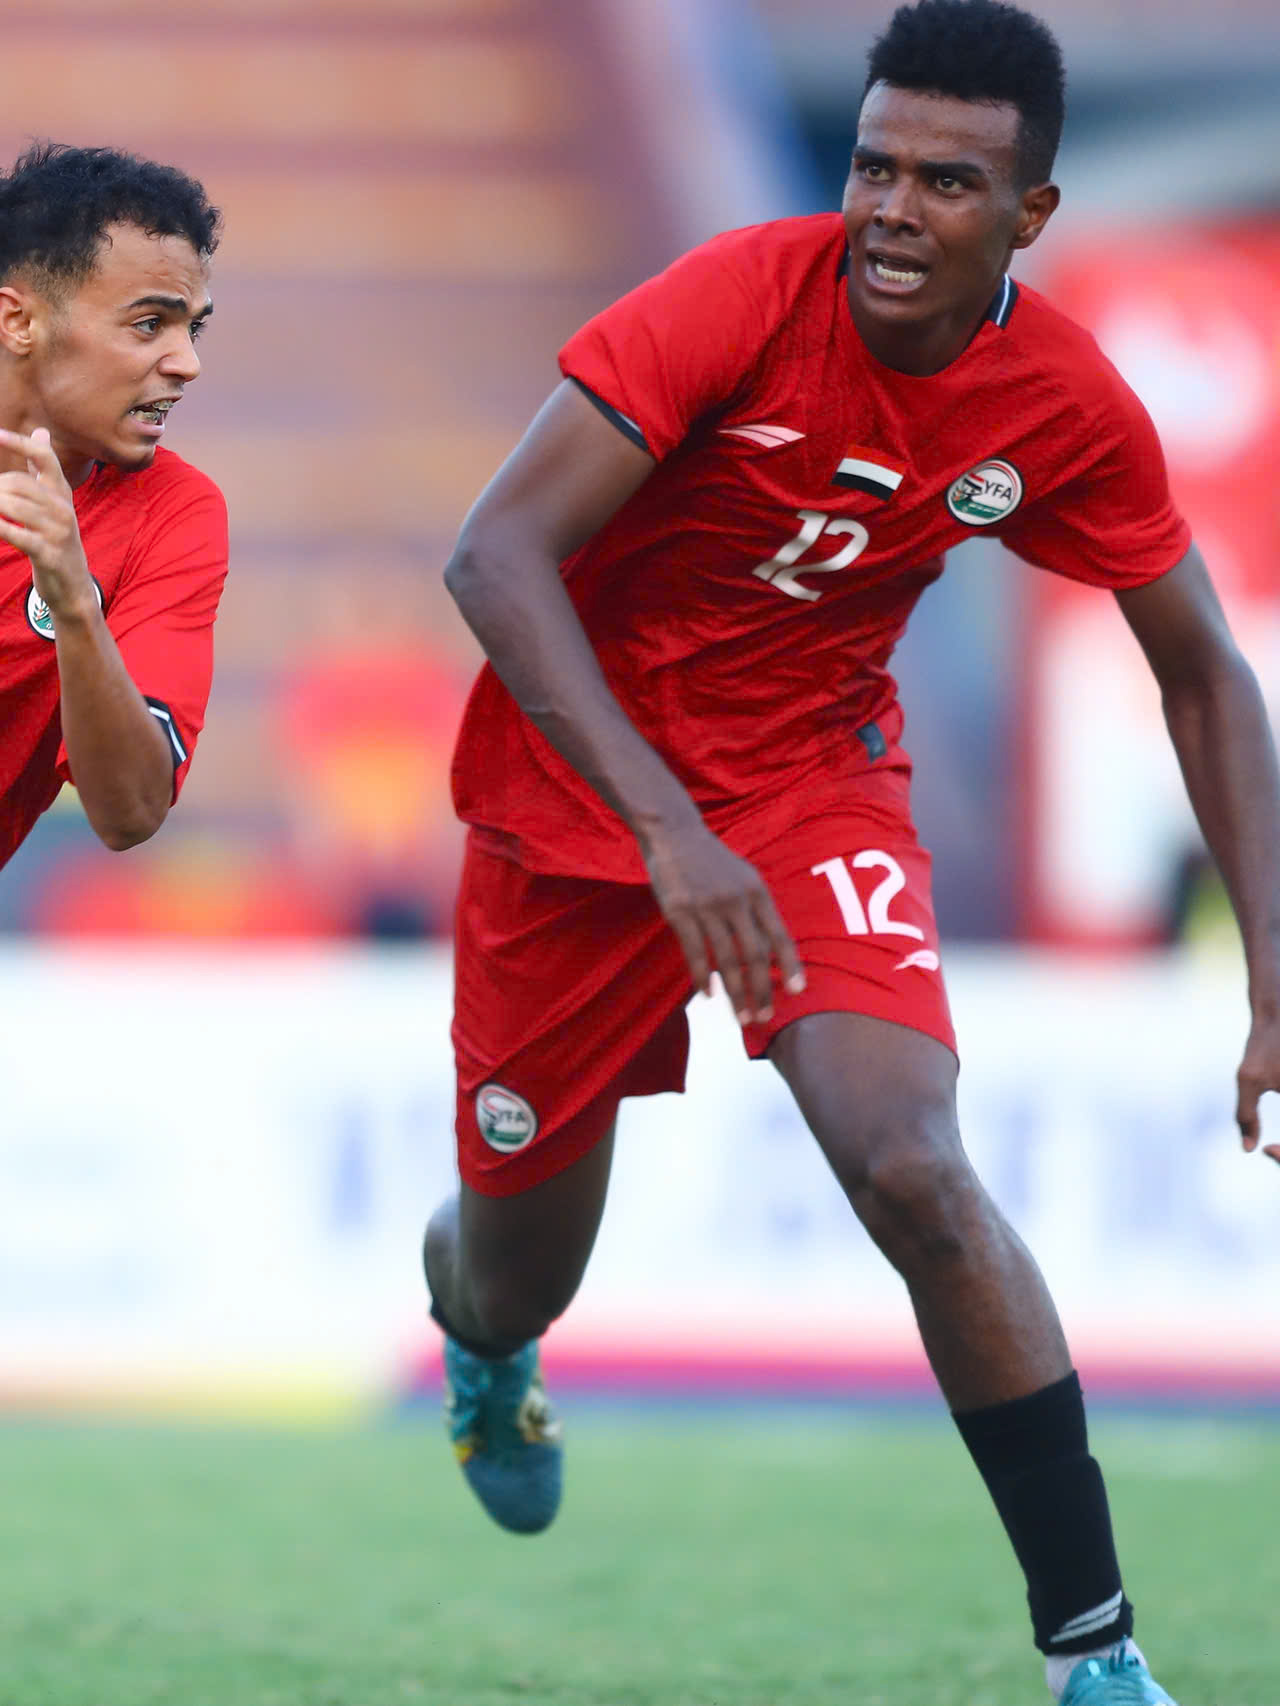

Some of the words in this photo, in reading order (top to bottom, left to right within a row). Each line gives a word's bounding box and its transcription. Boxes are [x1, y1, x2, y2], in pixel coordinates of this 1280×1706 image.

[984, 480, 1012, 501] YFA
[752, 510, 869, 602] 12
[811, 849, 925, 941] 12
